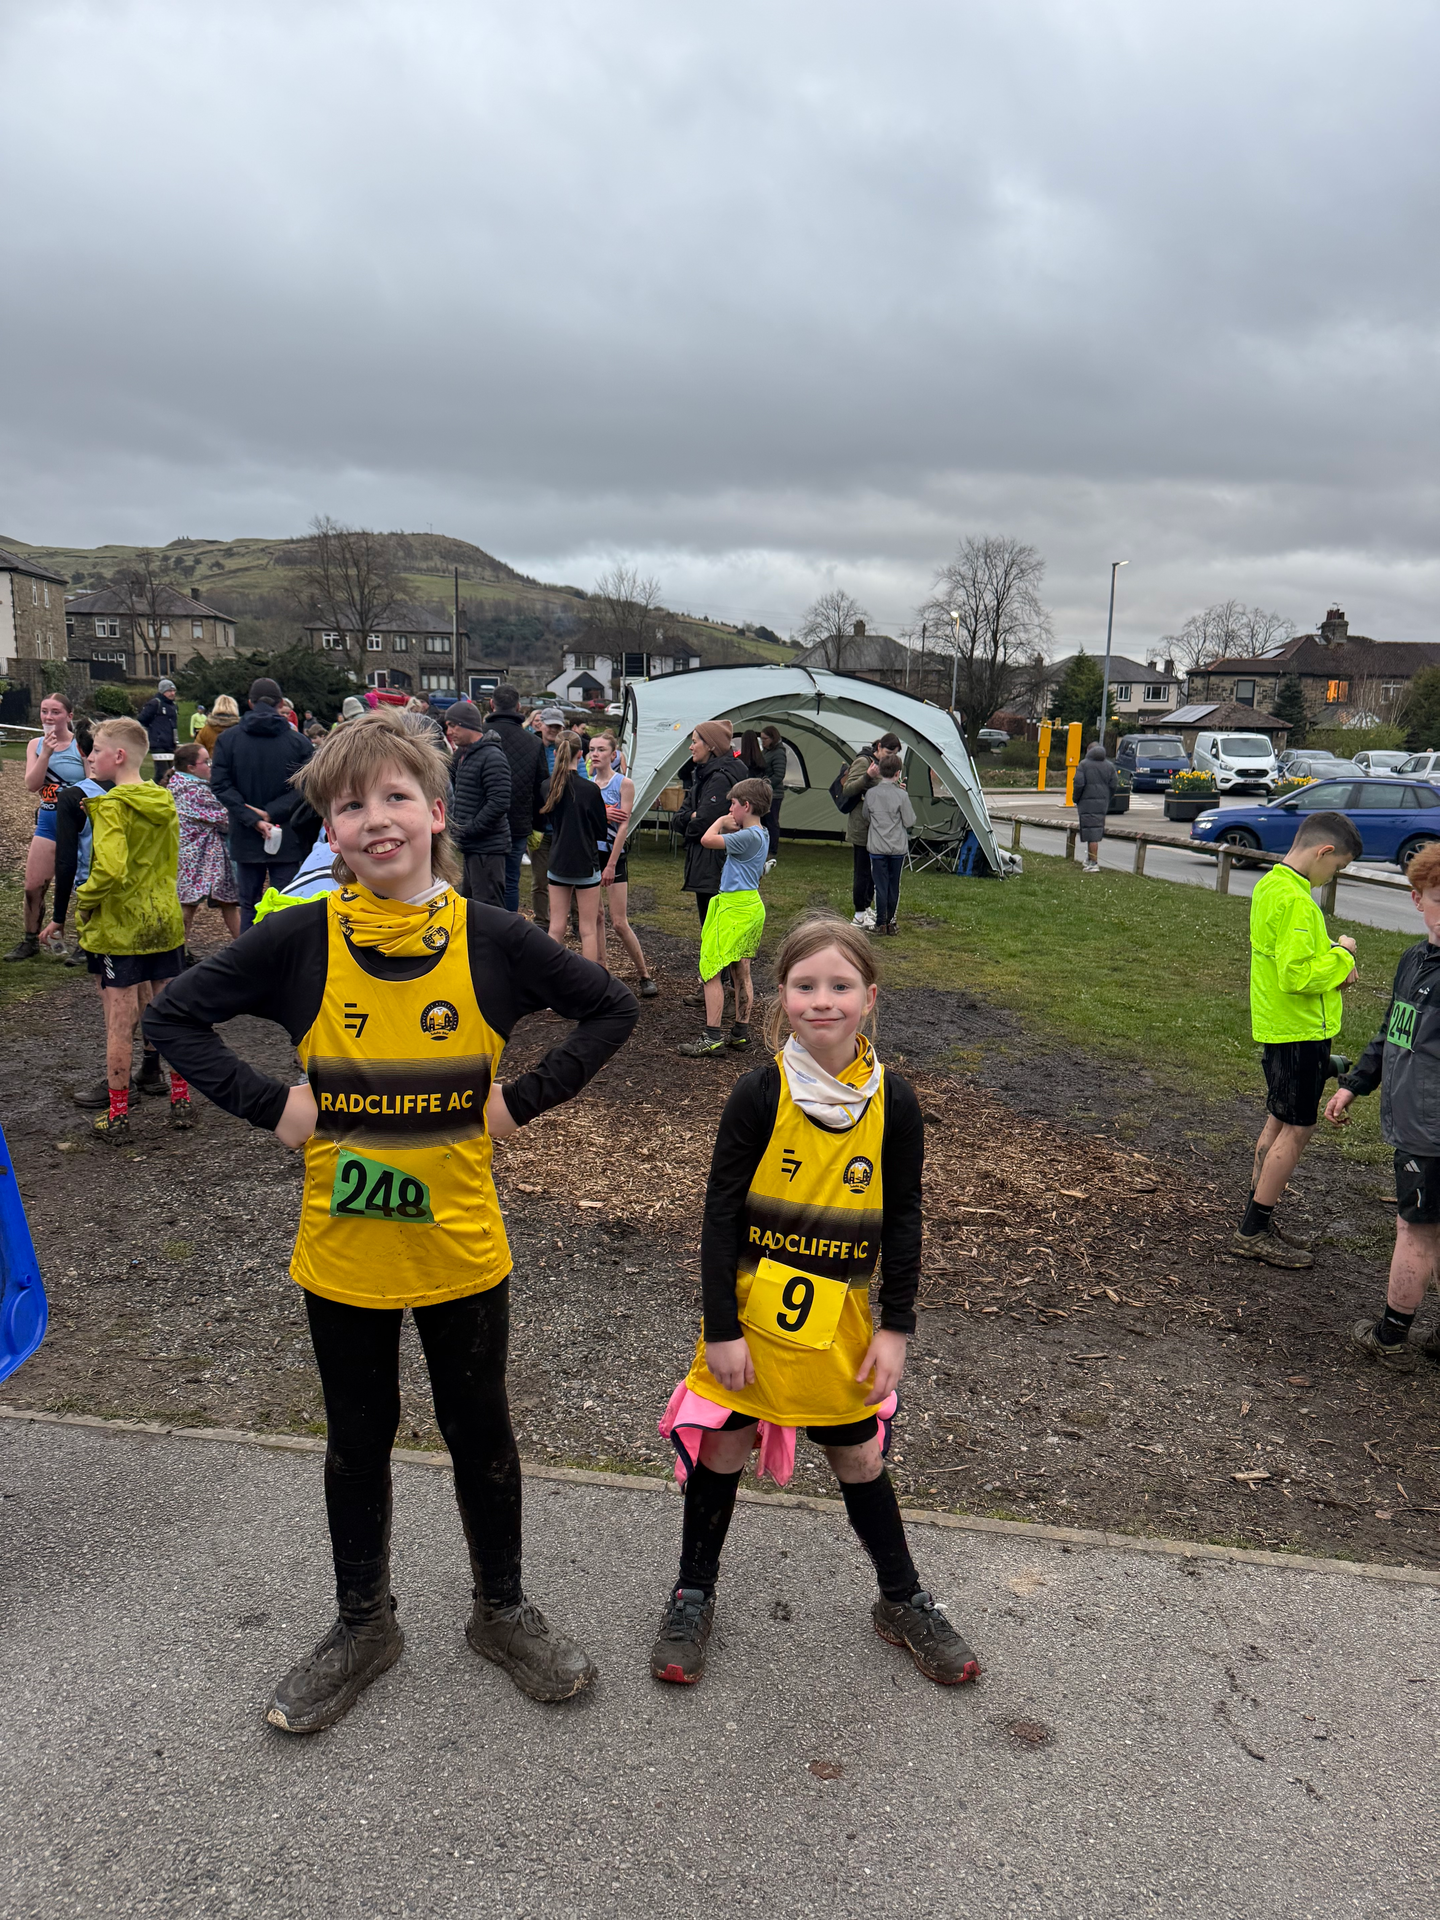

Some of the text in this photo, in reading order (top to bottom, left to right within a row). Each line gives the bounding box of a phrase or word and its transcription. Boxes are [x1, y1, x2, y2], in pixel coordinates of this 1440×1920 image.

[1389, 1004, 1414, 1044] 244
[321, 1090, 474, 1114] RADCLIFFE AC
[336, 1160, 427, 1218] 248
[749, 1226, 852, 1259] RADCLIFFE
[776, 1276, 815, 1333] 9
